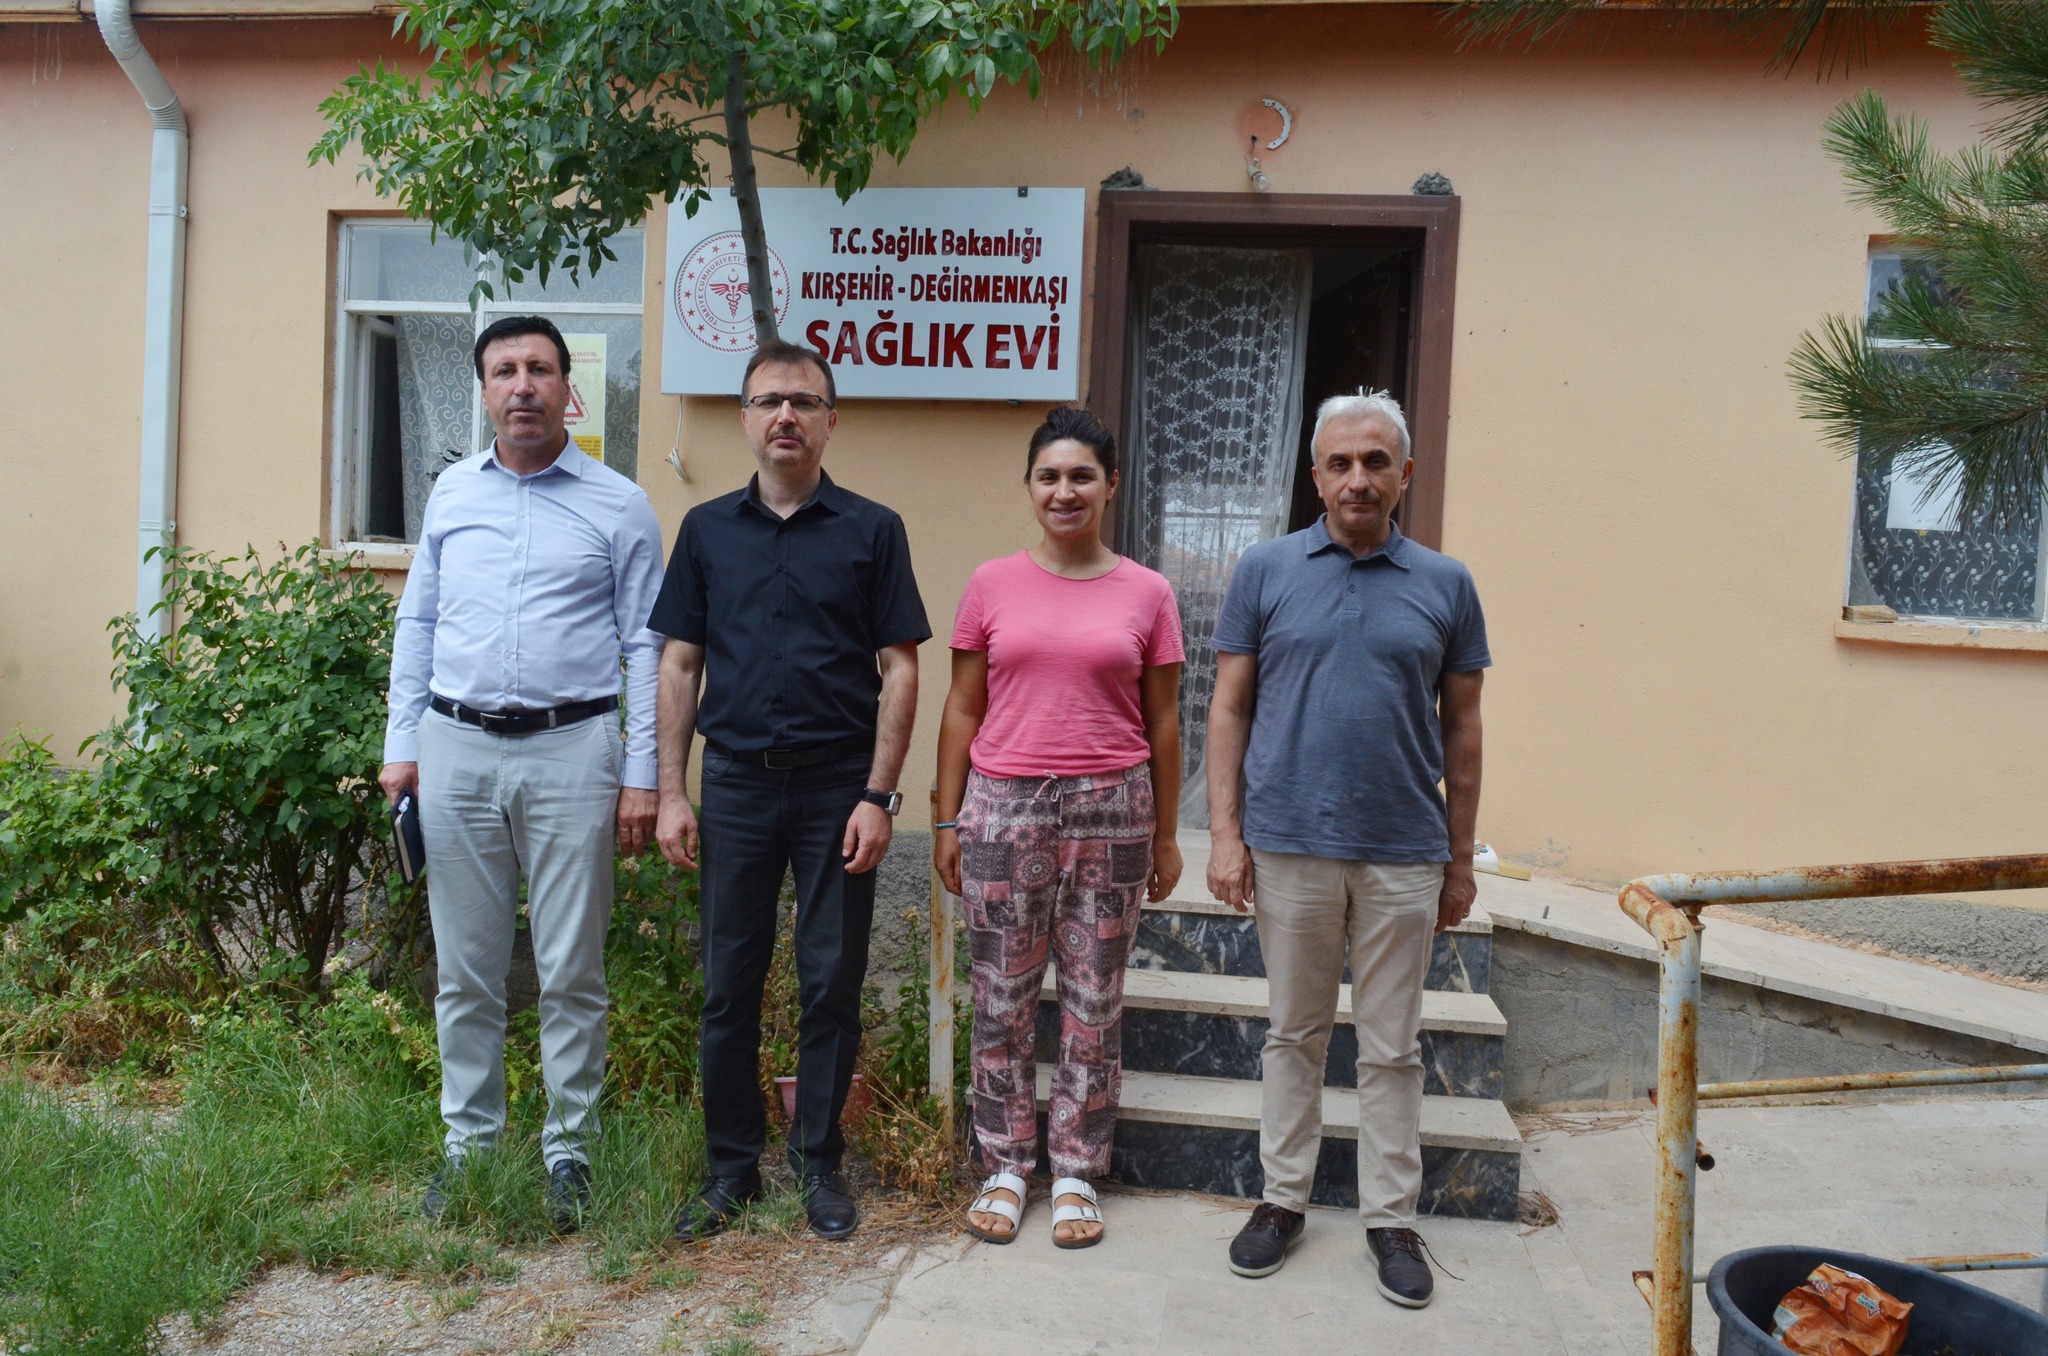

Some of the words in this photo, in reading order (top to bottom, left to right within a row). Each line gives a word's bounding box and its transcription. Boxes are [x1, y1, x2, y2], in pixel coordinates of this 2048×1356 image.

[830, 228, 867, 255] T.C.
[871, 226, 938, 263] Sağlık
[942, 228, 1042, 265] Bakanlığı
[698, 255, 741, 292] CUMHURİYETİ
[801, 264, 894, 308] KIRŞEHİR
[911, 266, 1068, 312] DEĞİRMENKAŞI
[698, 294, 718, 326] TÜRKİYE
[806, 310, 975, 368] SAĞLIK
[986, 312, 1060, 371] EVİ
[571, 384, 586, 406] Kontrol
